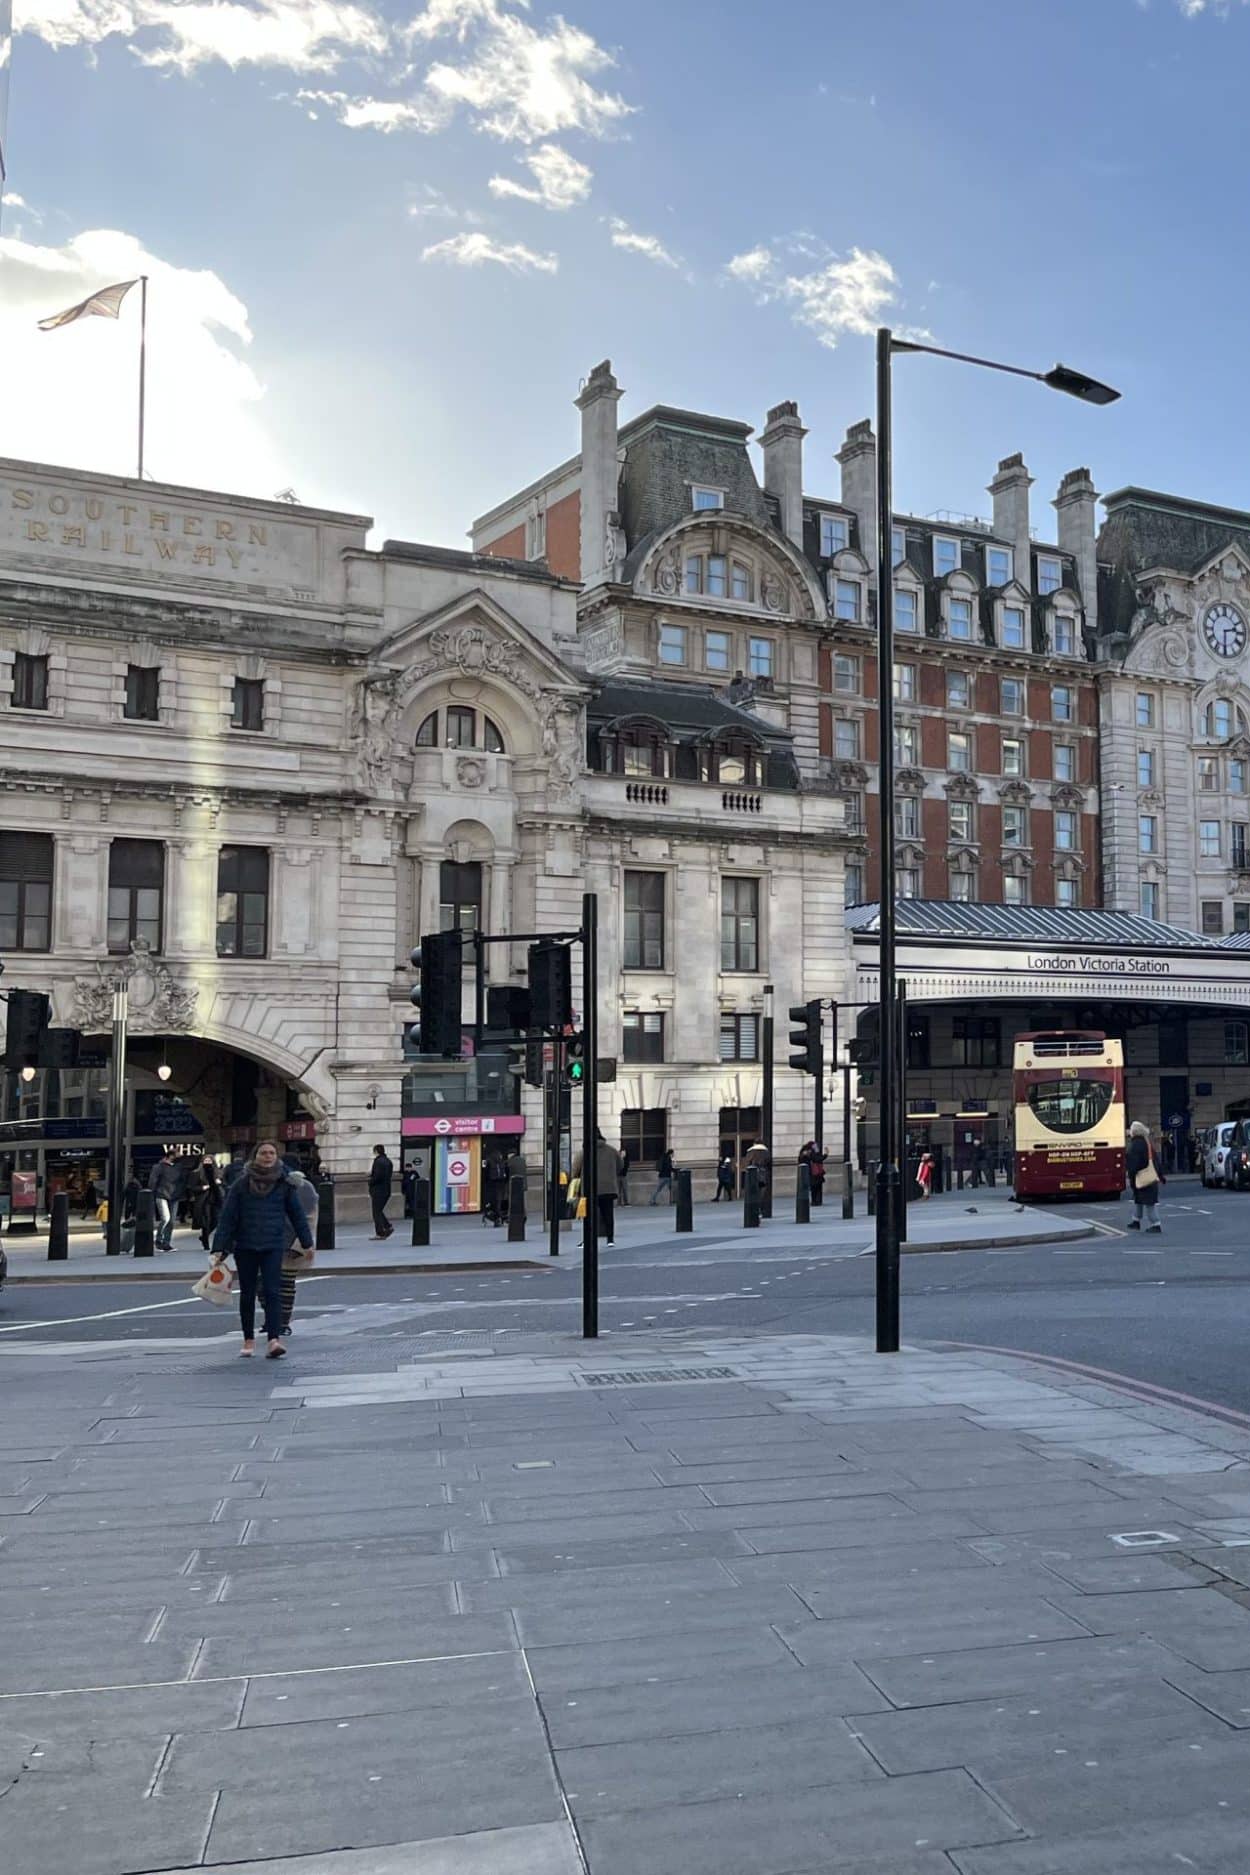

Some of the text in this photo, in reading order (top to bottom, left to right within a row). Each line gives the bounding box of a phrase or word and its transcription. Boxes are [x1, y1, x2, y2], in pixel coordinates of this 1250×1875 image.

[11, 488, 269, 546] SOUTHERN
[24, 519, 244, 569] RAILWAY
[1027, 955, 1170, 972] London Victoria Station
